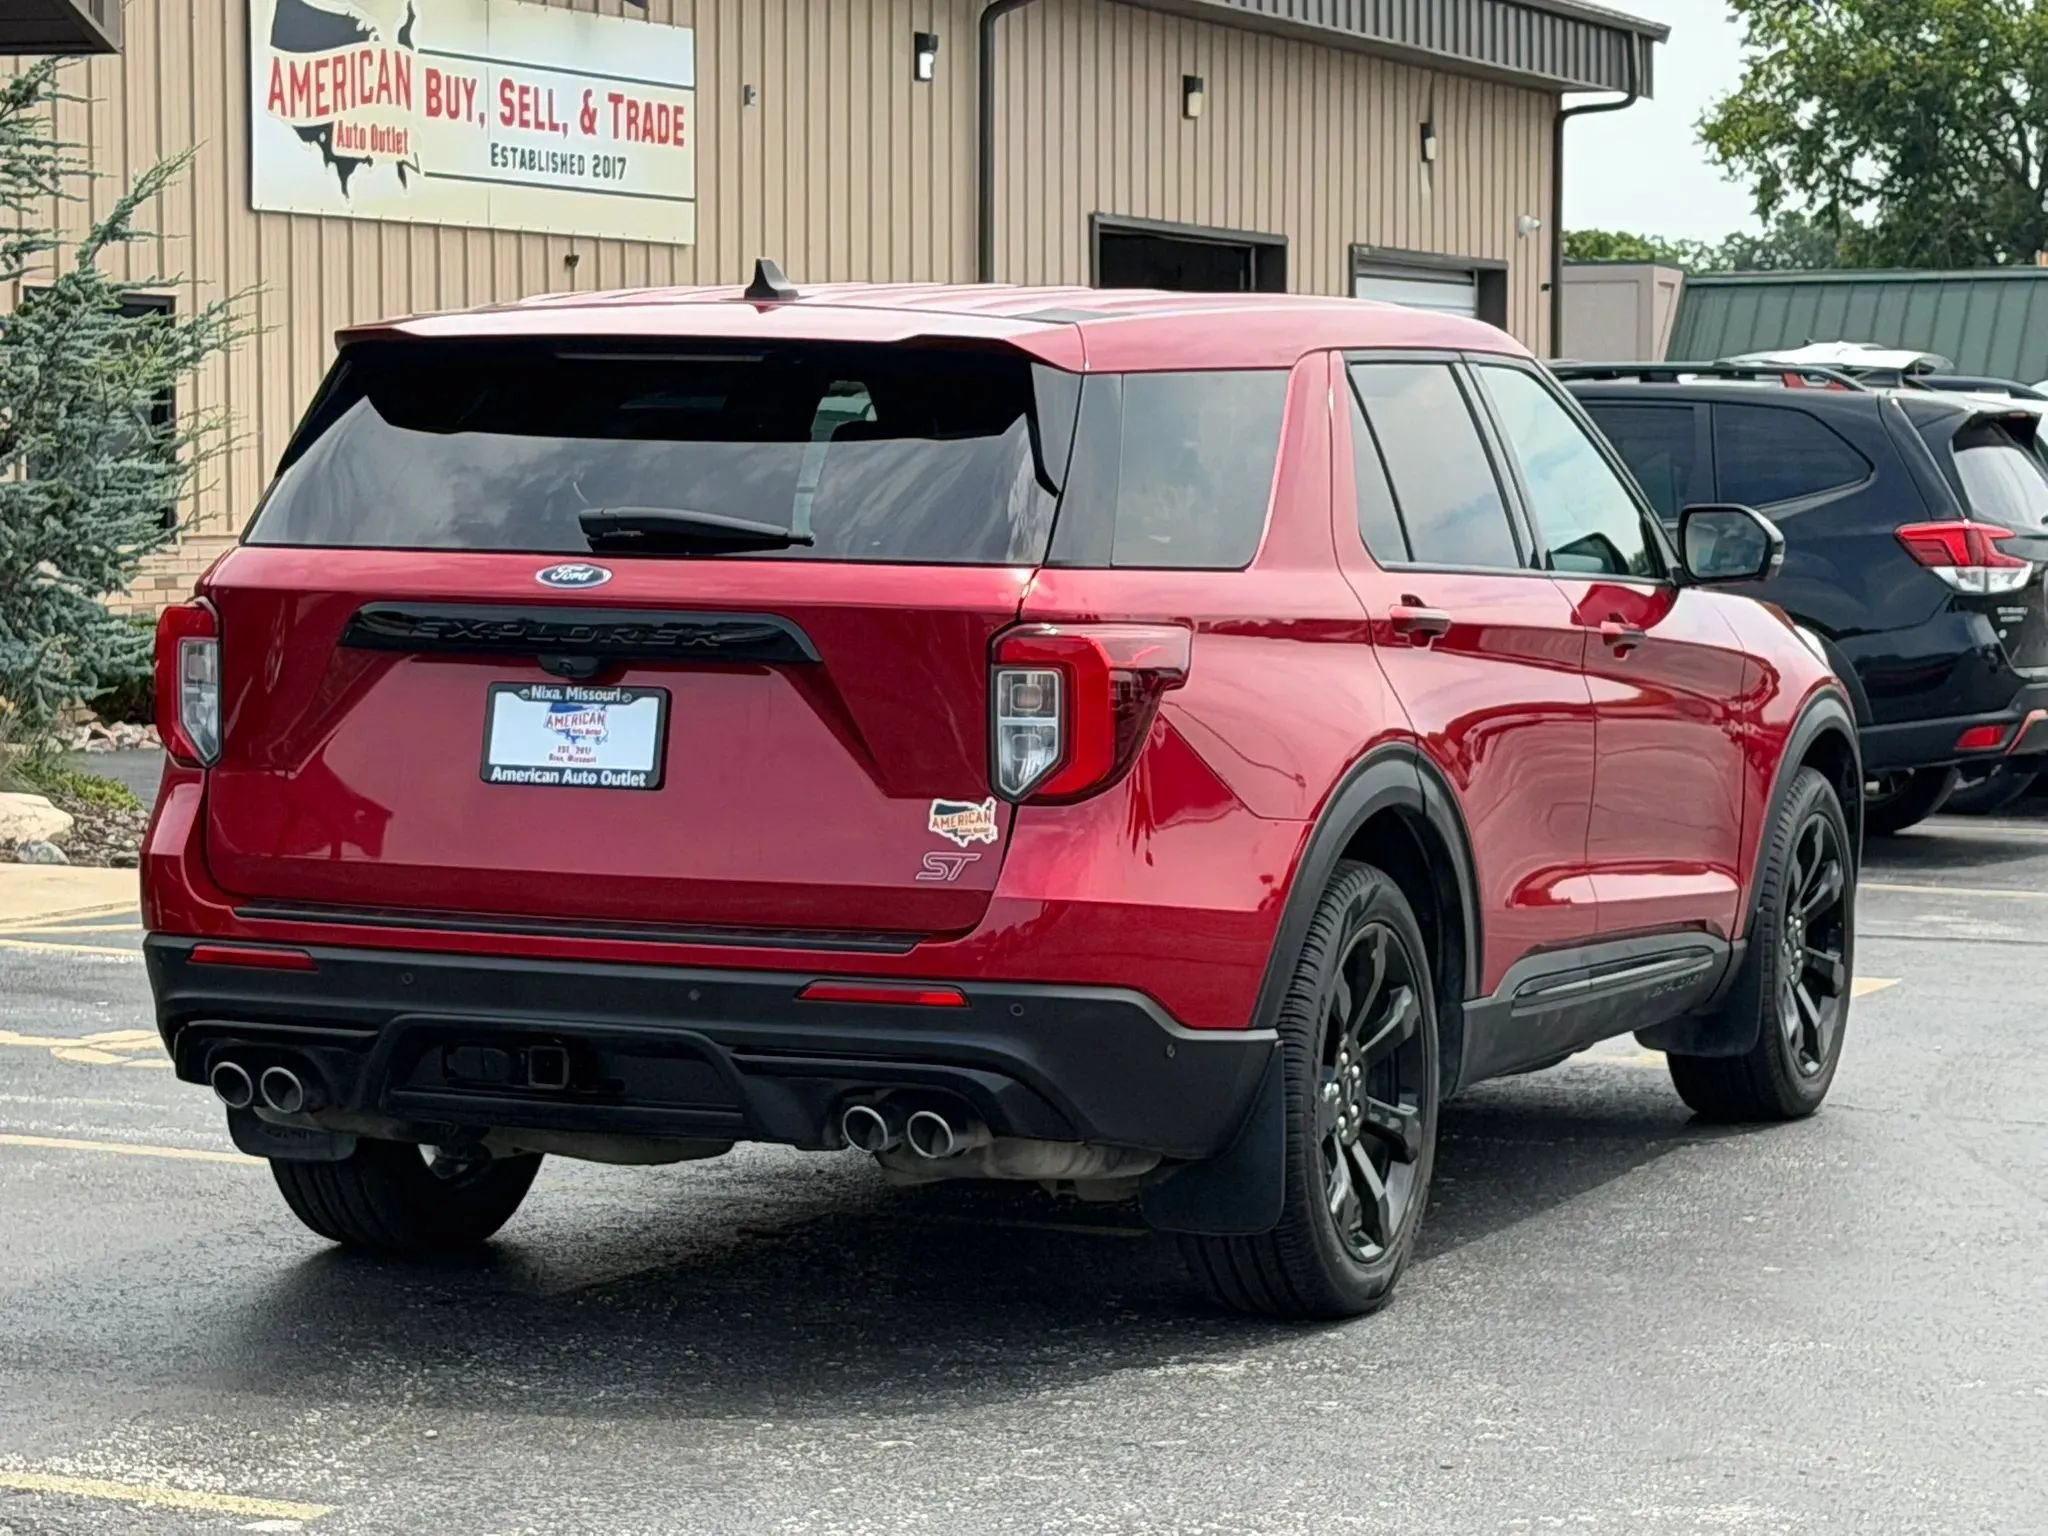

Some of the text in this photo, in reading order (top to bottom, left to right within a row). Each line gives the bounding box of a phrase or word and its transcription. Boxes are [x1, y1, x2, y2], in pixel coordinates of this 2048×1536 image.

[267, 48, 412, 118] AMERICAN
[425, 67, 685, 147] BUY, SELL, & TRADE
[336, 119, 409, 155] Auto Outlet
[490, 142, 627, 180] ESTABLISHED 2017
[551, 566, 595, 581] Ford
[410, 621, 721, 647] EXPLORER
[565, 686, 621, 702] Missouri
[545, 711, 605, 728] AMERICAN
[489, 766, 647, 788] American Auto Outlet
[931, 811, 992, 829] AMERICAN
[915, 851, 982, 881] ST
